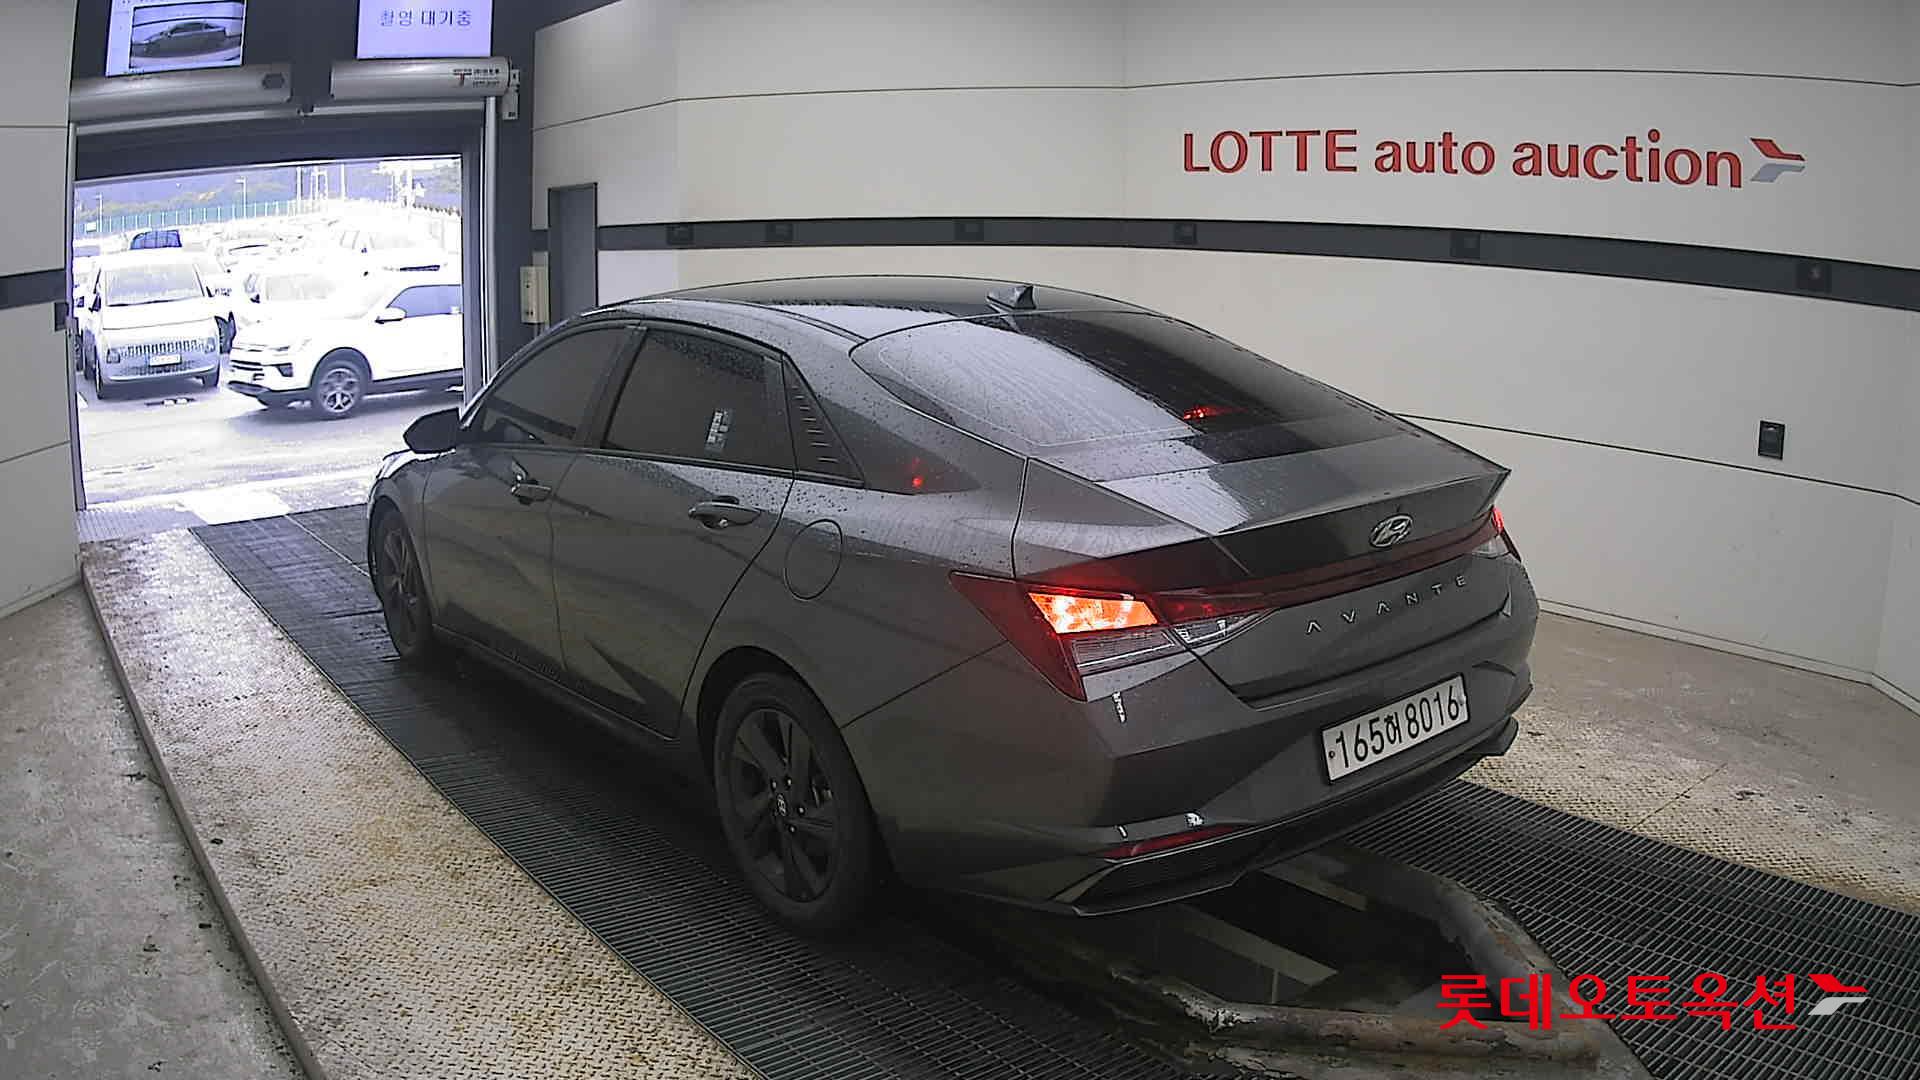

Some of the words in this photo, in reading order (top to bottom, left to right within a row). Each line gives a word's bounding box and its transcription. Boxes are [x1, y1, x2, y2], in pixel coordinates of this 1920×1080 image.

[1185, 131, 1358, 173] LOTTE
[1375, 132, 1494, 175] auto
[1513, 129, 1743, 188] auction
[1306, 575, 1467, 634] AVANTE
